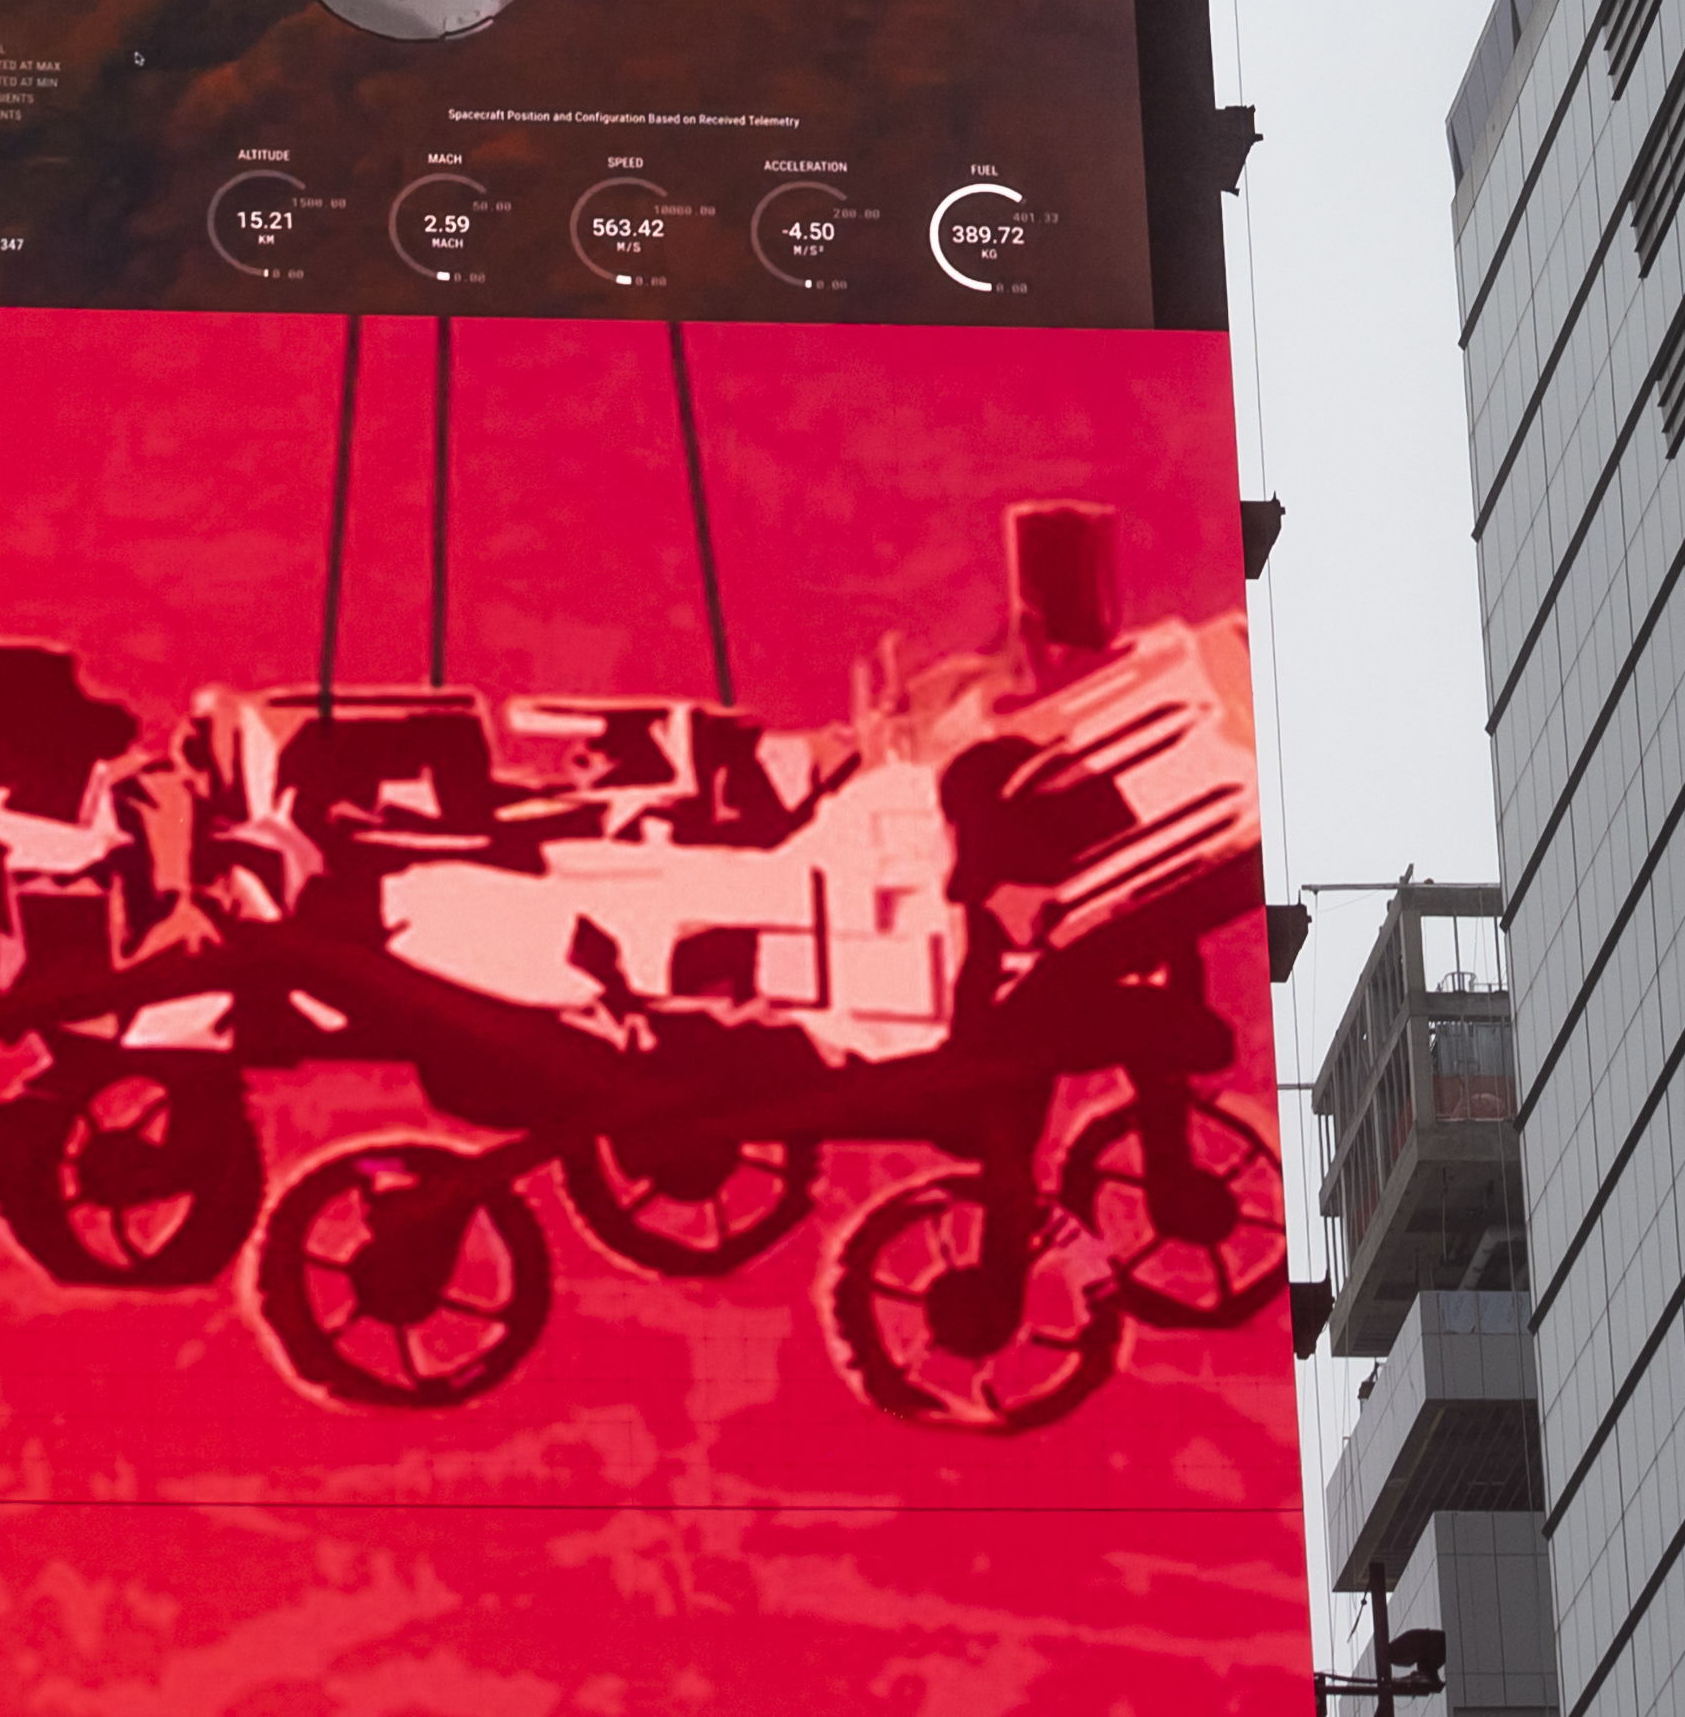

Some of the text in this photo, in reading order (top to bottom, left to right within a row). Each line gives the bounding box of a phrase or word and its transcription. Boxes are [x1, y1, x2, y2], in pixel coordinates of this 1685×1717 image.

[448, 108, 800, 130] Spacecraft Position and Configuration Based on Received Telemetry
[237, 149, 290, 162] ALTITUDE
[428, 153, 462, 165] MACH
[607, 156, 644, 169] SPEED
[763, 160, 848, 173] ACCELERATION
[970, 164, 999, 177] FUEL
[236, 210, 293, 230] 15.21
[423, 215, 471, 234] 2.59
[592, 218, 665, 238] 563.42
[781, 221, 836, 242] -4.50
[258, 234, 275, 246] KM
[951, 225, 1025, 245] 389.72
[0, 238, 24, 251] 347
[432, 238, 464, 250] MACH
[616, 242, 641, 254] M/S
[981, 248, 998, 260] KG
